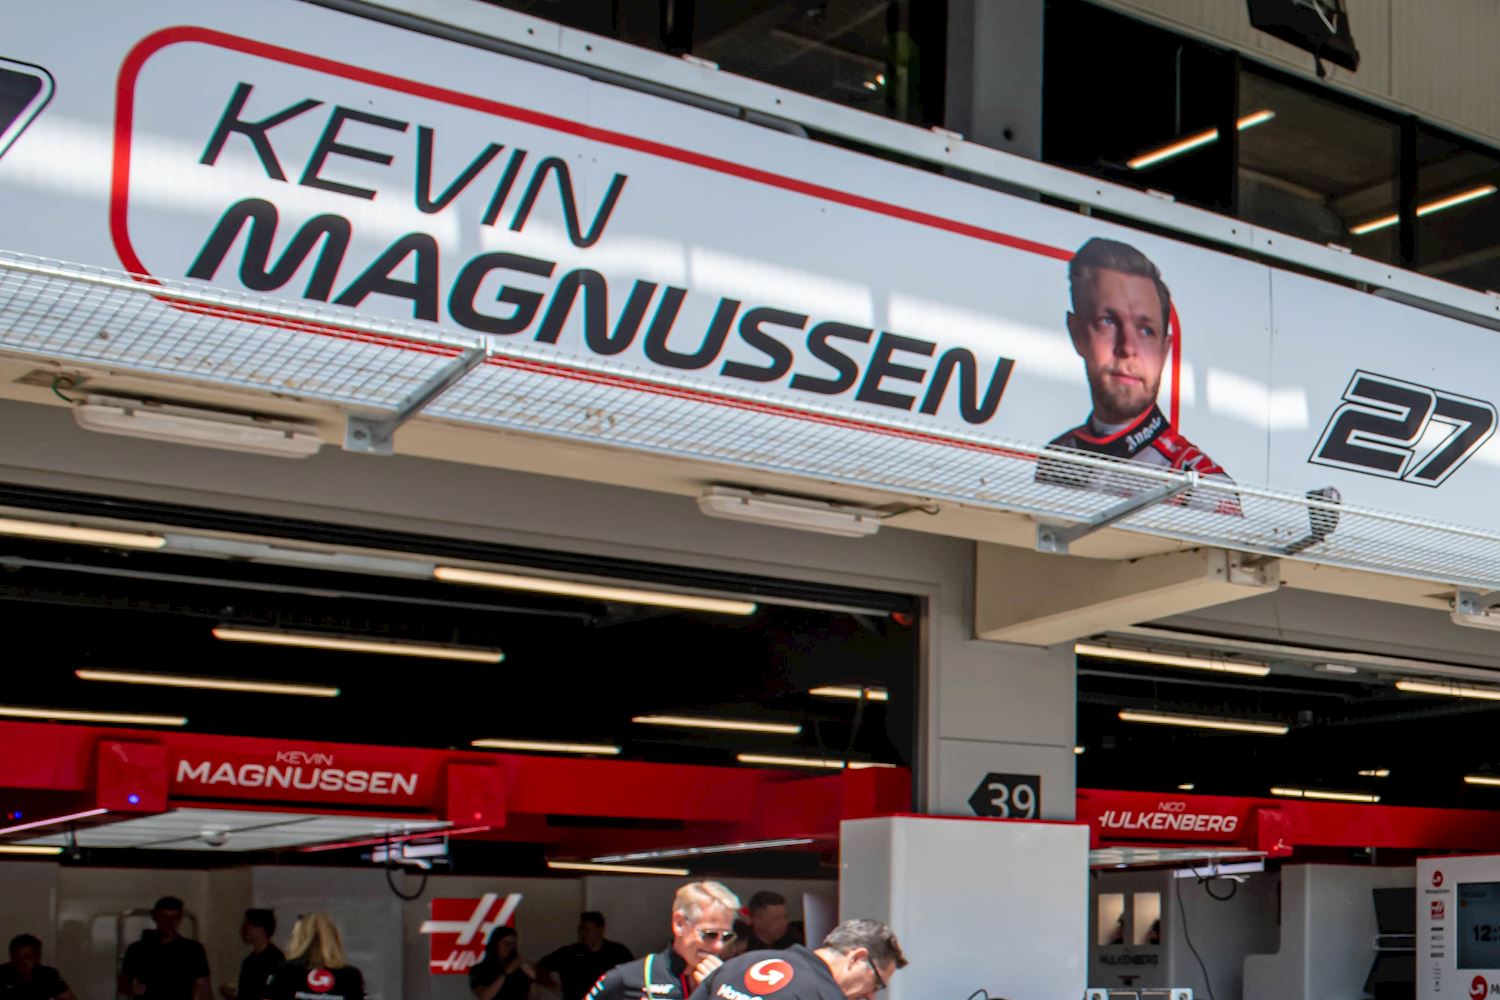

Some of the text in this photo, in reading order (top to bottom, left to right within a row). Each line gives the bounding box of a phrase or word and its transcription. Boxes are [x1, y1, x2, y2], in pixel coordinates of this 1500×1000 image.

[200, 82, 627, 248] KEVIN
[186, 198, 1014, 424] MAGNUSSEN
[1308, 369, 1498, 487] 27
[276, 751, 333, 766] KEVIN
[176, 759, 418, 796] MAGNUSSEN
[987, 783, 1036, 820] 39
[1158, 801, 1186, 813] NICO
